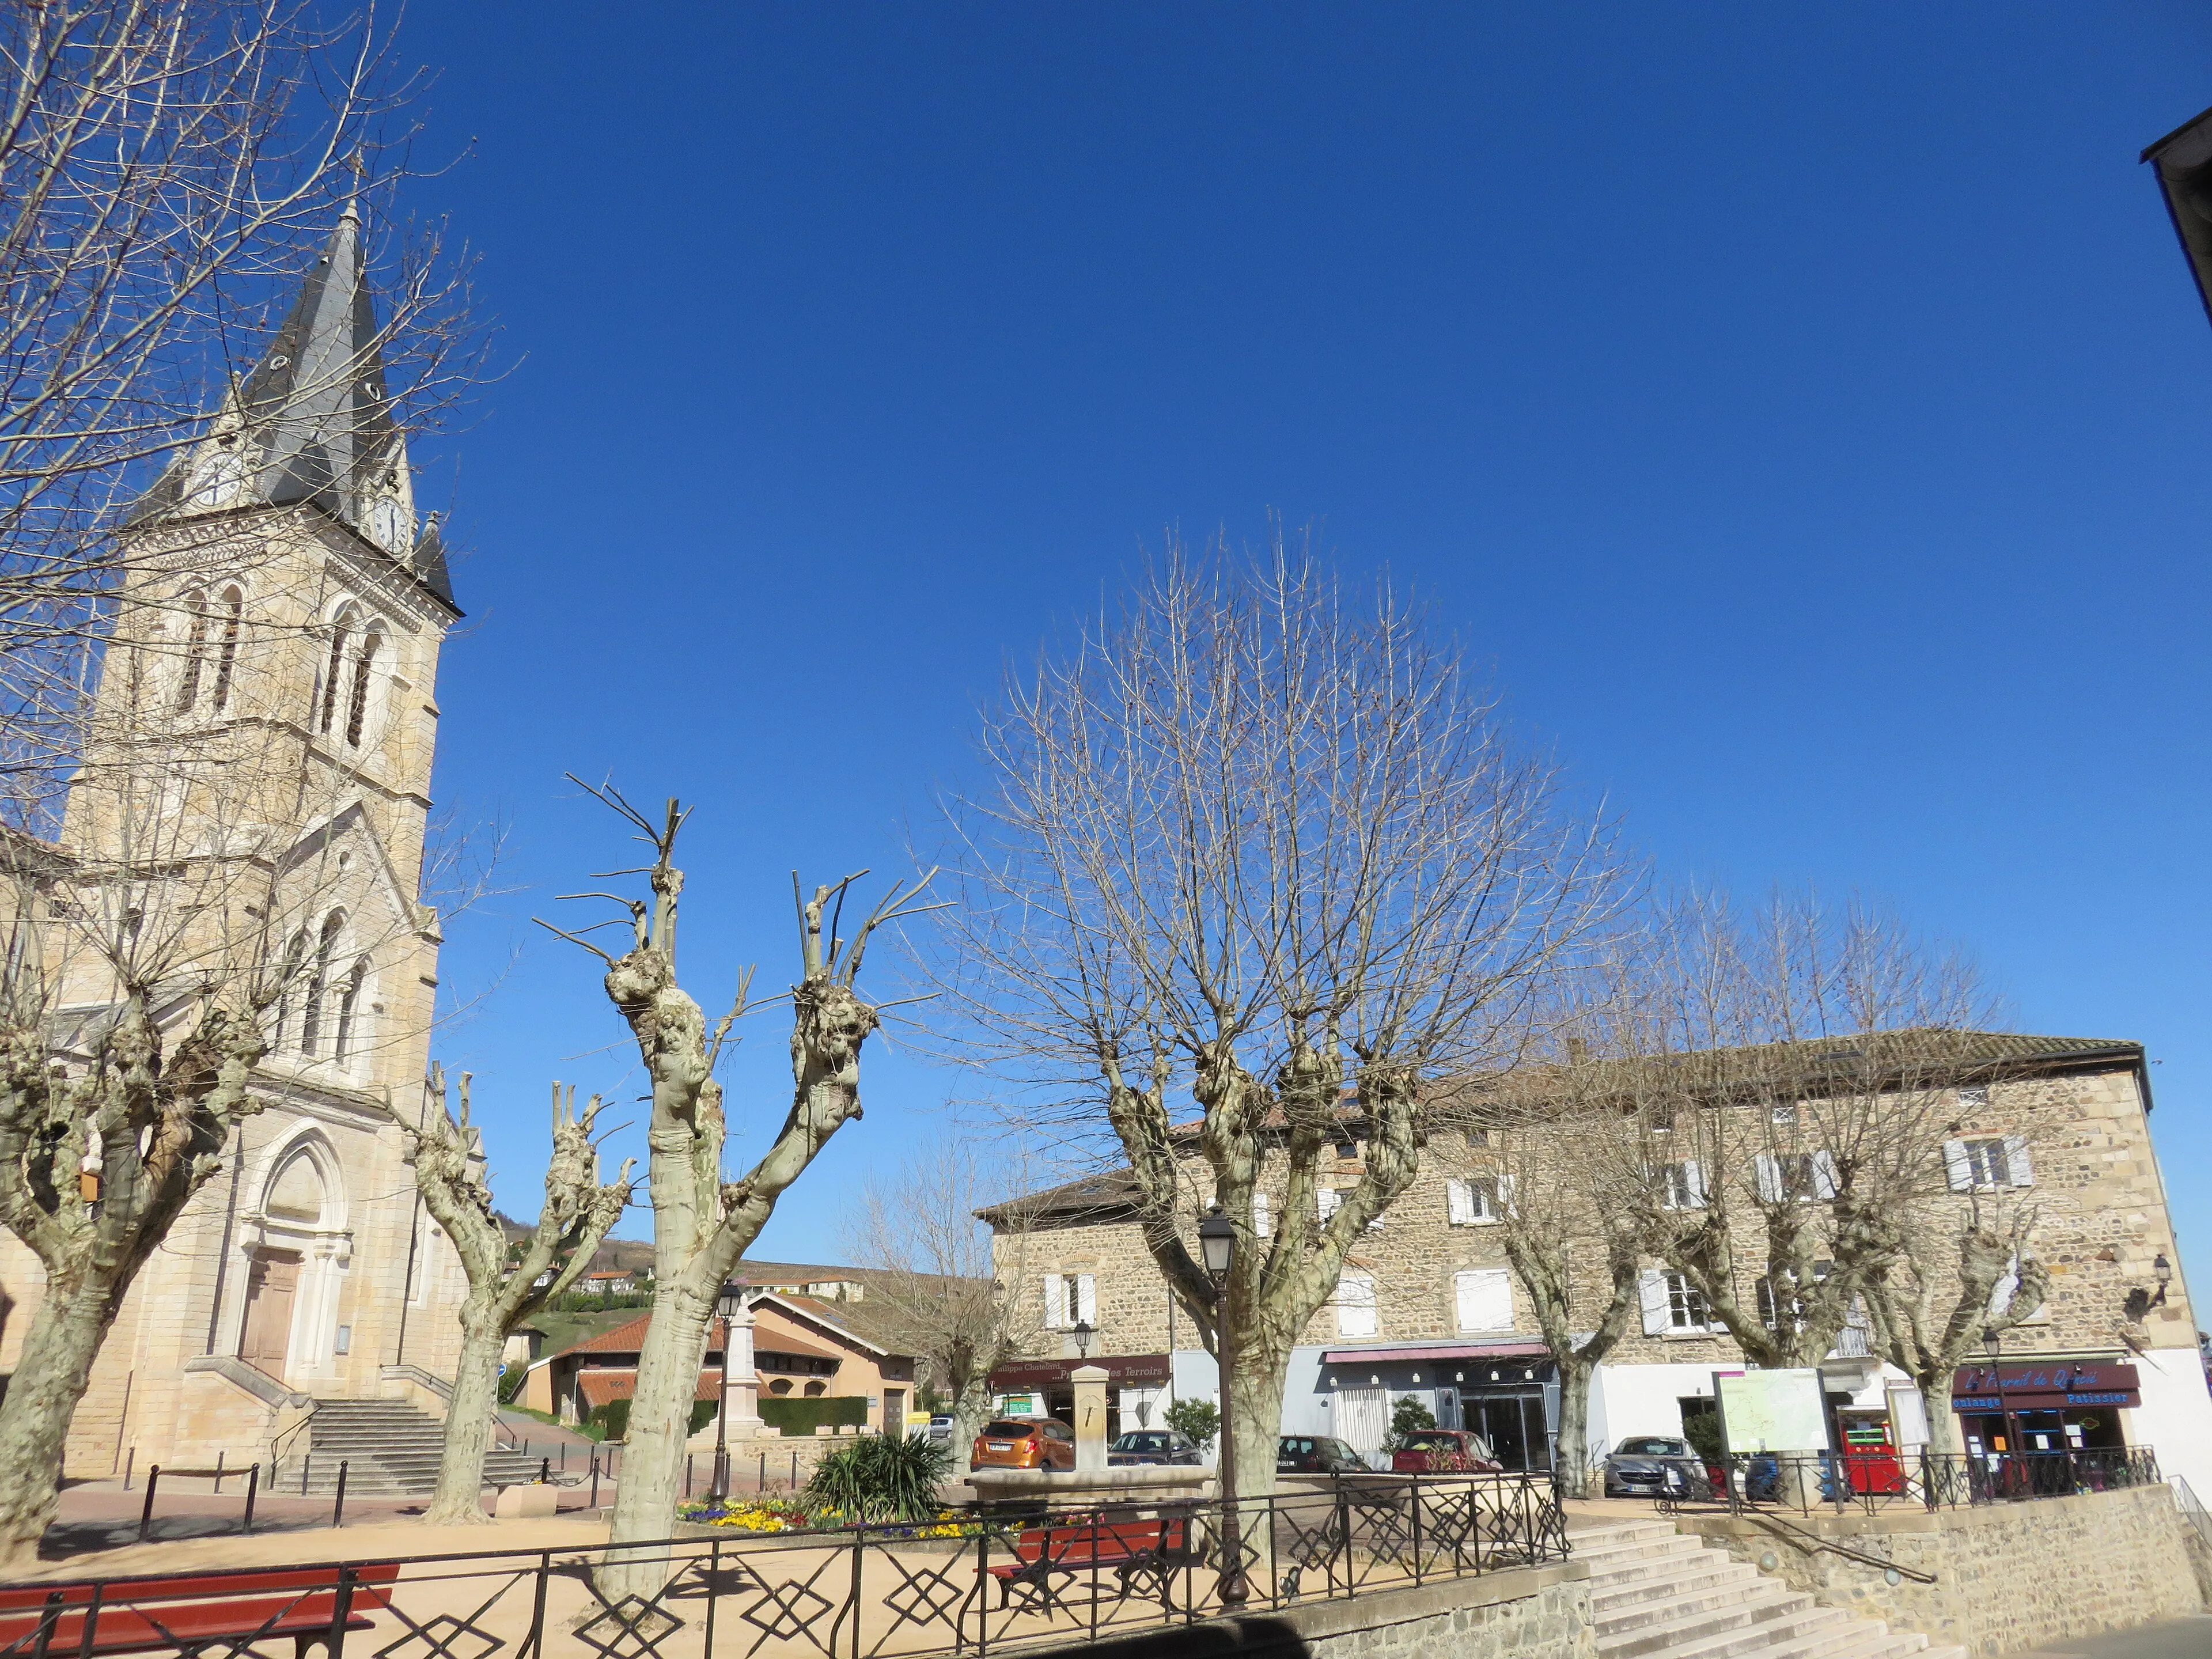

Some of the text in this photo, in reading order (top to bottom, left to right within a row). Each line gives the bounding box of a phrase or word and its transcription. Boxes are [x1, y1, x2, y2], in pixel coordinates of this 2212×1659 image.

[1125, 1366, 1162, 1376] Terroirs
[2033, 1372, 2048, 1385] de
[2066, 1393, 2128, 1404] Patissier
